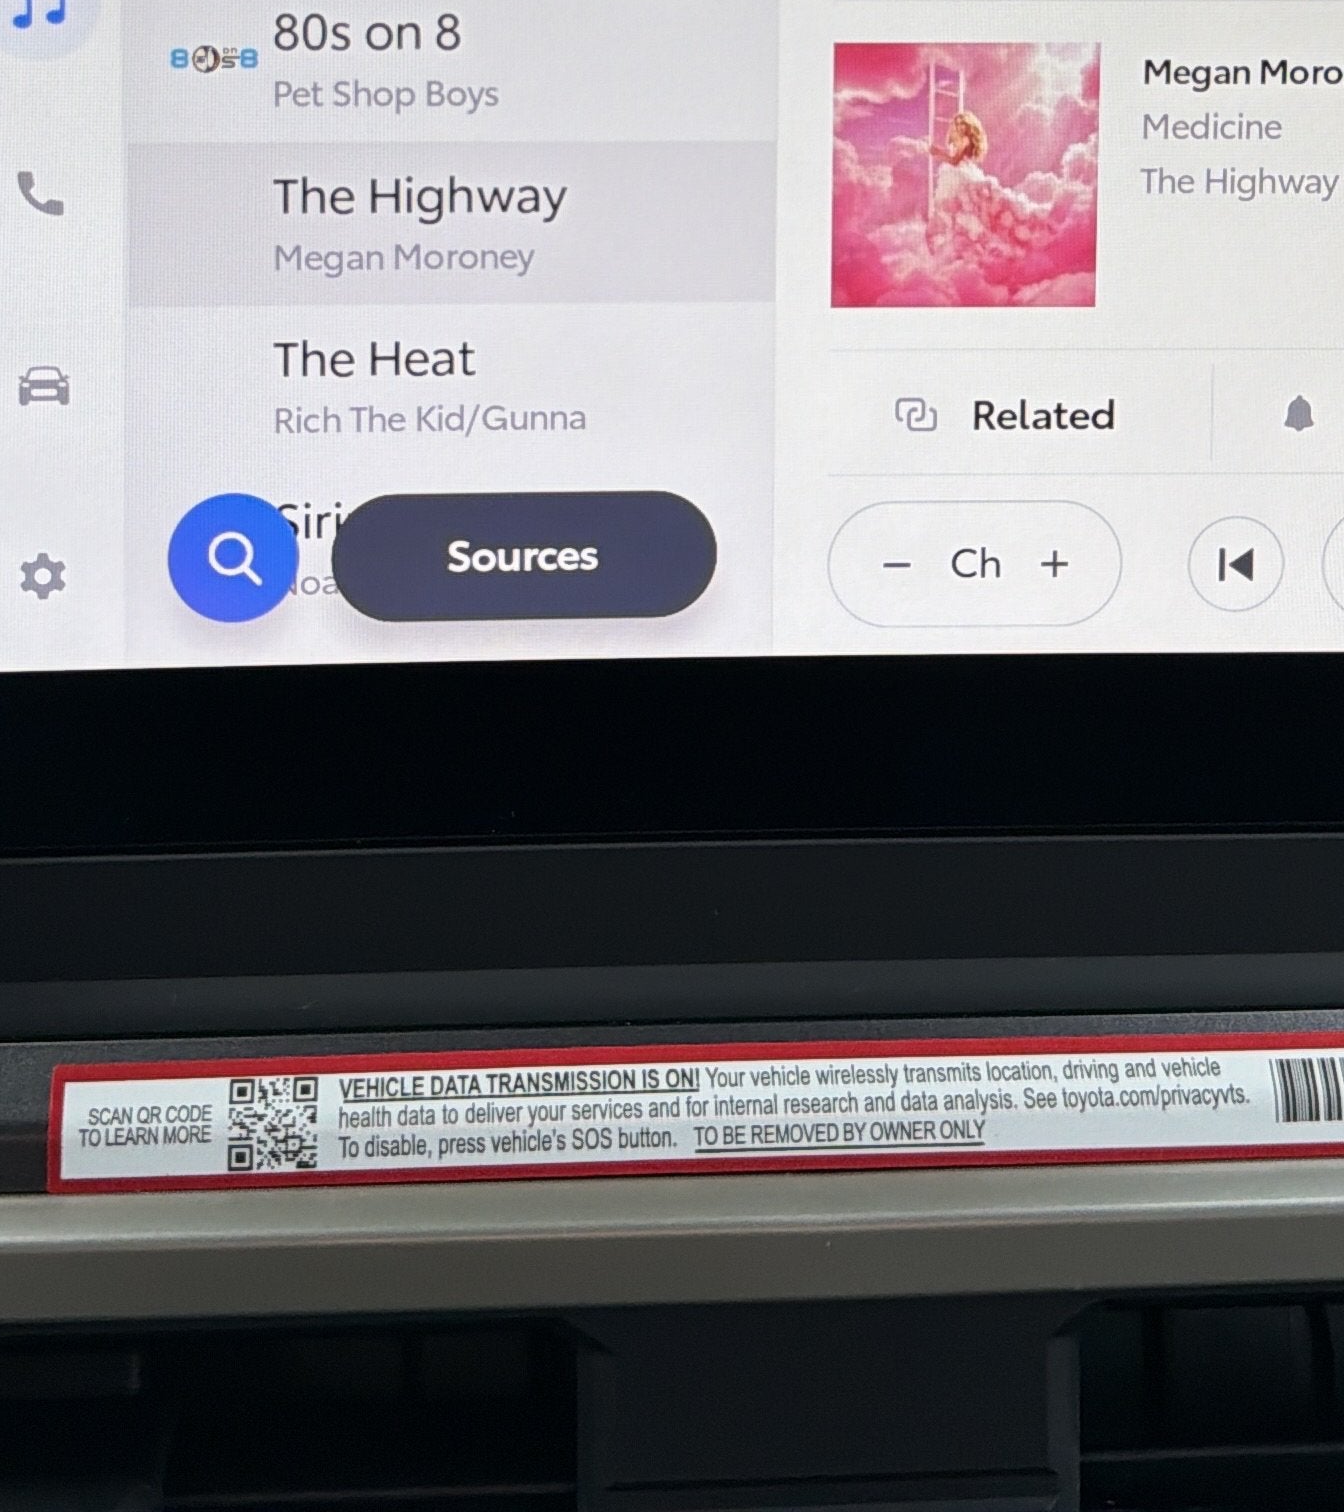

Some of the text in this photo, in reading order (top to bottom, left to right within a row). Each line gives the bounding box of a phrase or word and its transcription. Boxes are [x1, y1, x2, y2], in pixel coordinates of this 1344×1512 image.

[274, 12, 460, 51] 80s on 8
[1143, 59, 1250, 91] Megan
[274, 79, 498, 114] Pet Shop Boys
[1142, 112, 1282, 140] Medicine
[1141, 166, 1194, 193] The
[1205, 166, 1339, 199] Highway
[274, 177, 568, 224] The Highway
[274, 244, 535, 278] Megan Moroney
[274, 340, 476, 377] The Heat
[275, 404, 587, 436] Rich The Kid/Gunna
[973, 397, 1115, 432] Related
[277, 502, 347, 537] Siri
[448, 541, 599, 572] Sources
[952, 547, 1001, 578] Ch
[340, 1056, 1220, 1098] VEHICLE DATA TRANSMISSION IS ON! Your vehicle wirelessly transmits location, driving and vehicle
[88, 1103, 212, 1124] SCAN QR CODE
[339, 1084, 1250, 1129] health data to deliver your services and for internal research and data analysis. See toyota.com/privacyvts.
[79, 1124, 212, 1146] TO LEARN MORE
[338, 1118, 985, 1158] To disable, press vehicle's SOS button. TO BE REMOVED BY OWNER ONLY
